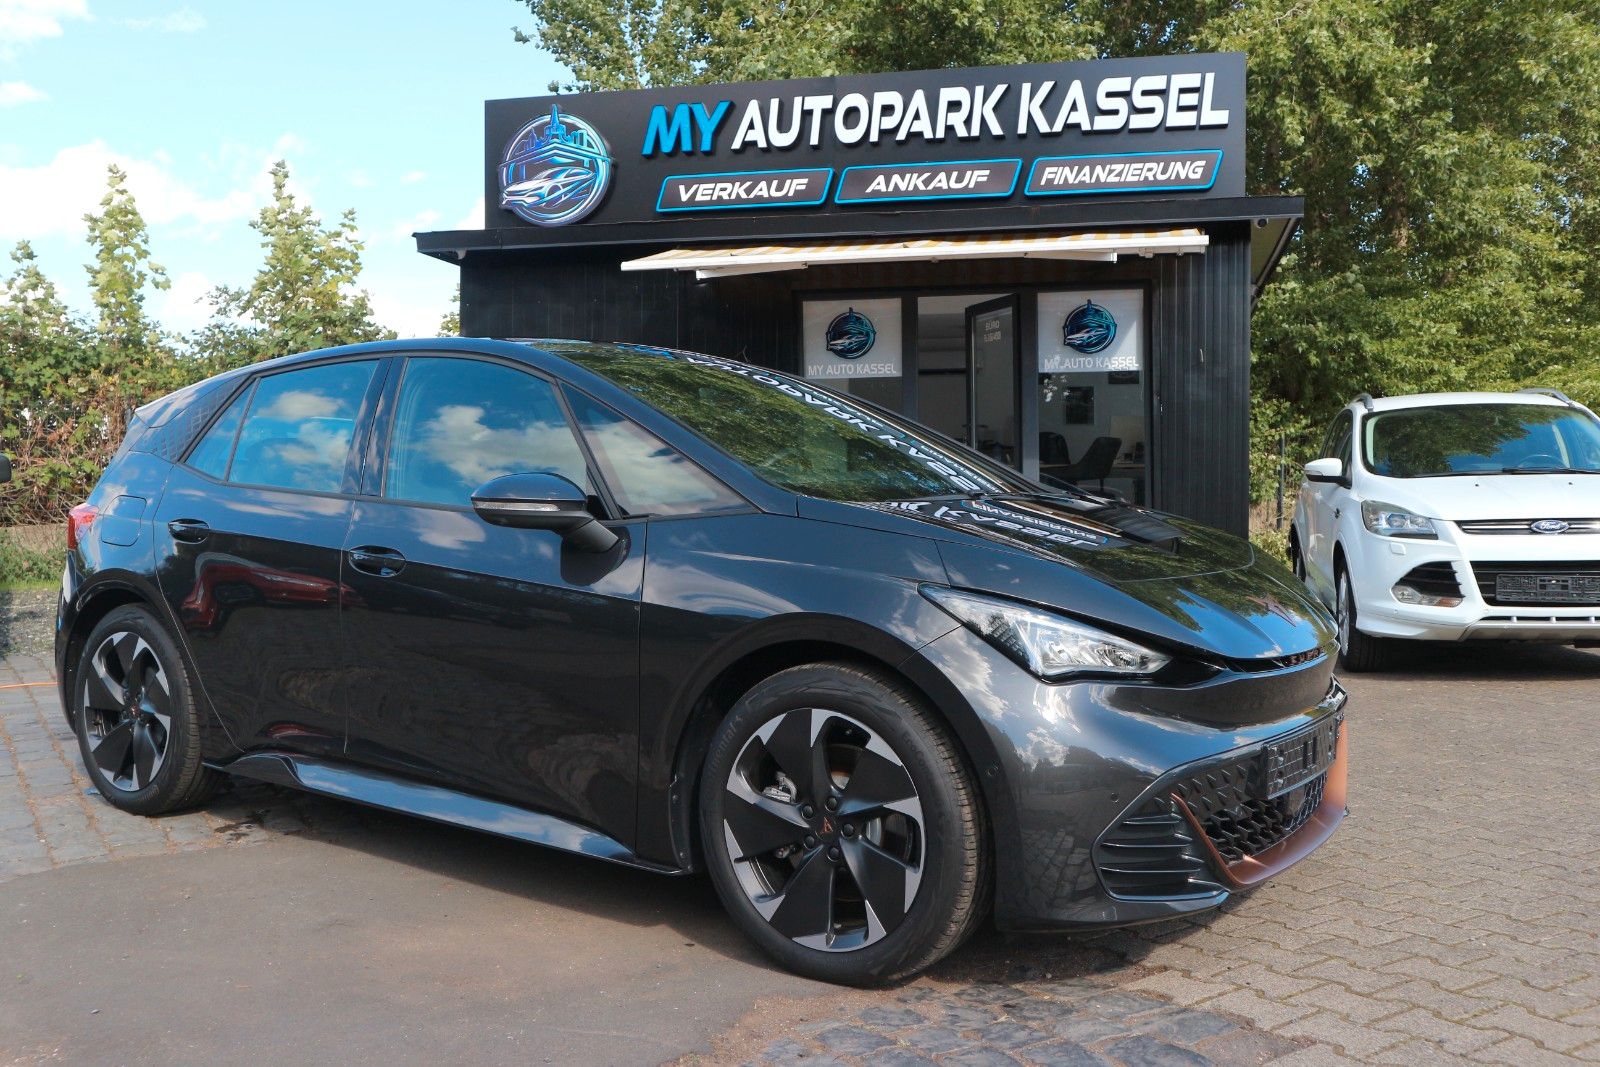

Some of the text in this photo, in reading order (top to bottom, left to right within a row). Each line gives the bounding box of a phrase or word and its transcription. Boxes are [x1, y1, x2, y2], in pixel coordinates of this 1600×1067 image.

[642, 73, 1230, 155] MY AUTOPARK KASSEL
[865, 170, 990, 193] ANKAUF
[1040, 160, 1206, 186] FINANZIERUNG
[678, 178, 808, 202] VERKAUF
[808, 362, 897, 377] MY AUTO KASSEL
[1064, 357, 1093, 369] AUTO
[1095, 355, 1139, 368] KASSEL
